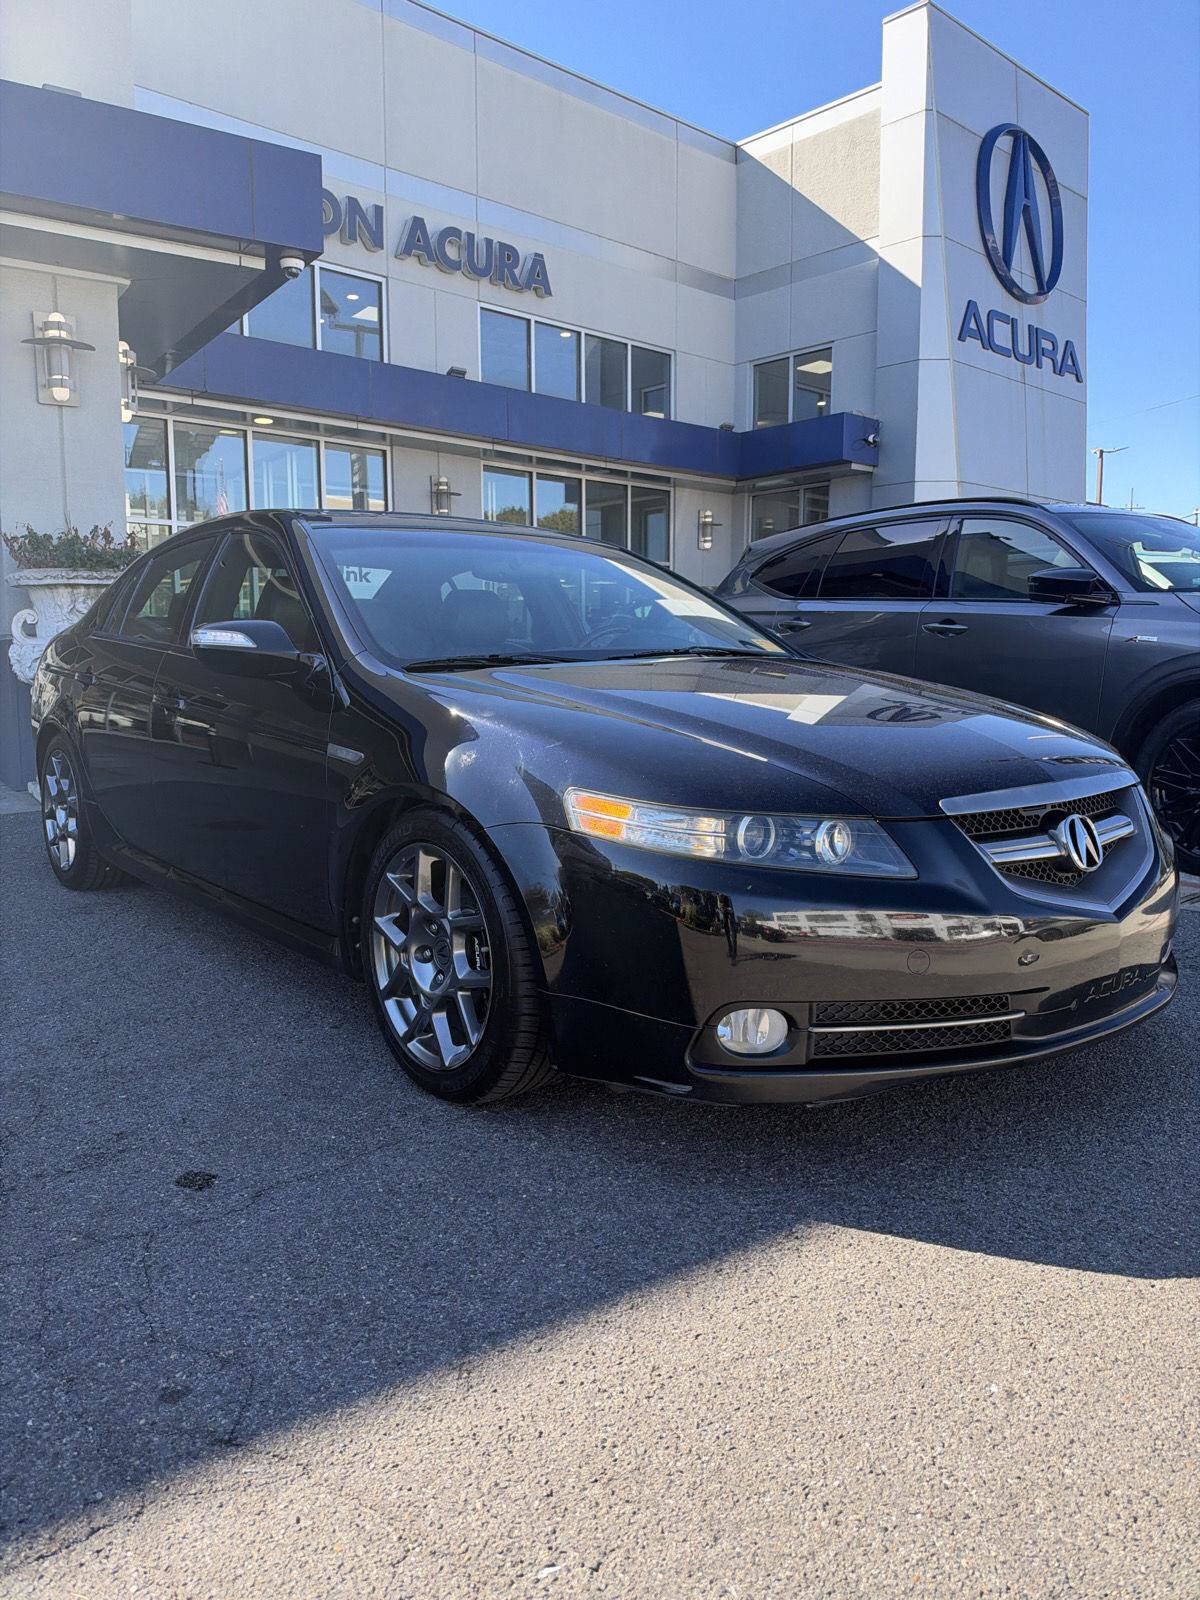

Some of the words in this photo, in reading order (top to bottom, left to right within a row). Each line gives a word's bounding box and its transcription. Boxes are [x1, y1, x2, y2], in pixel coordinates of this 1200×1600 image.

[395, 215, 553, 298] ACURA
[958, 299, 1083, 383] ACURA
[1083, 968, 1145, 1003] ACURA
